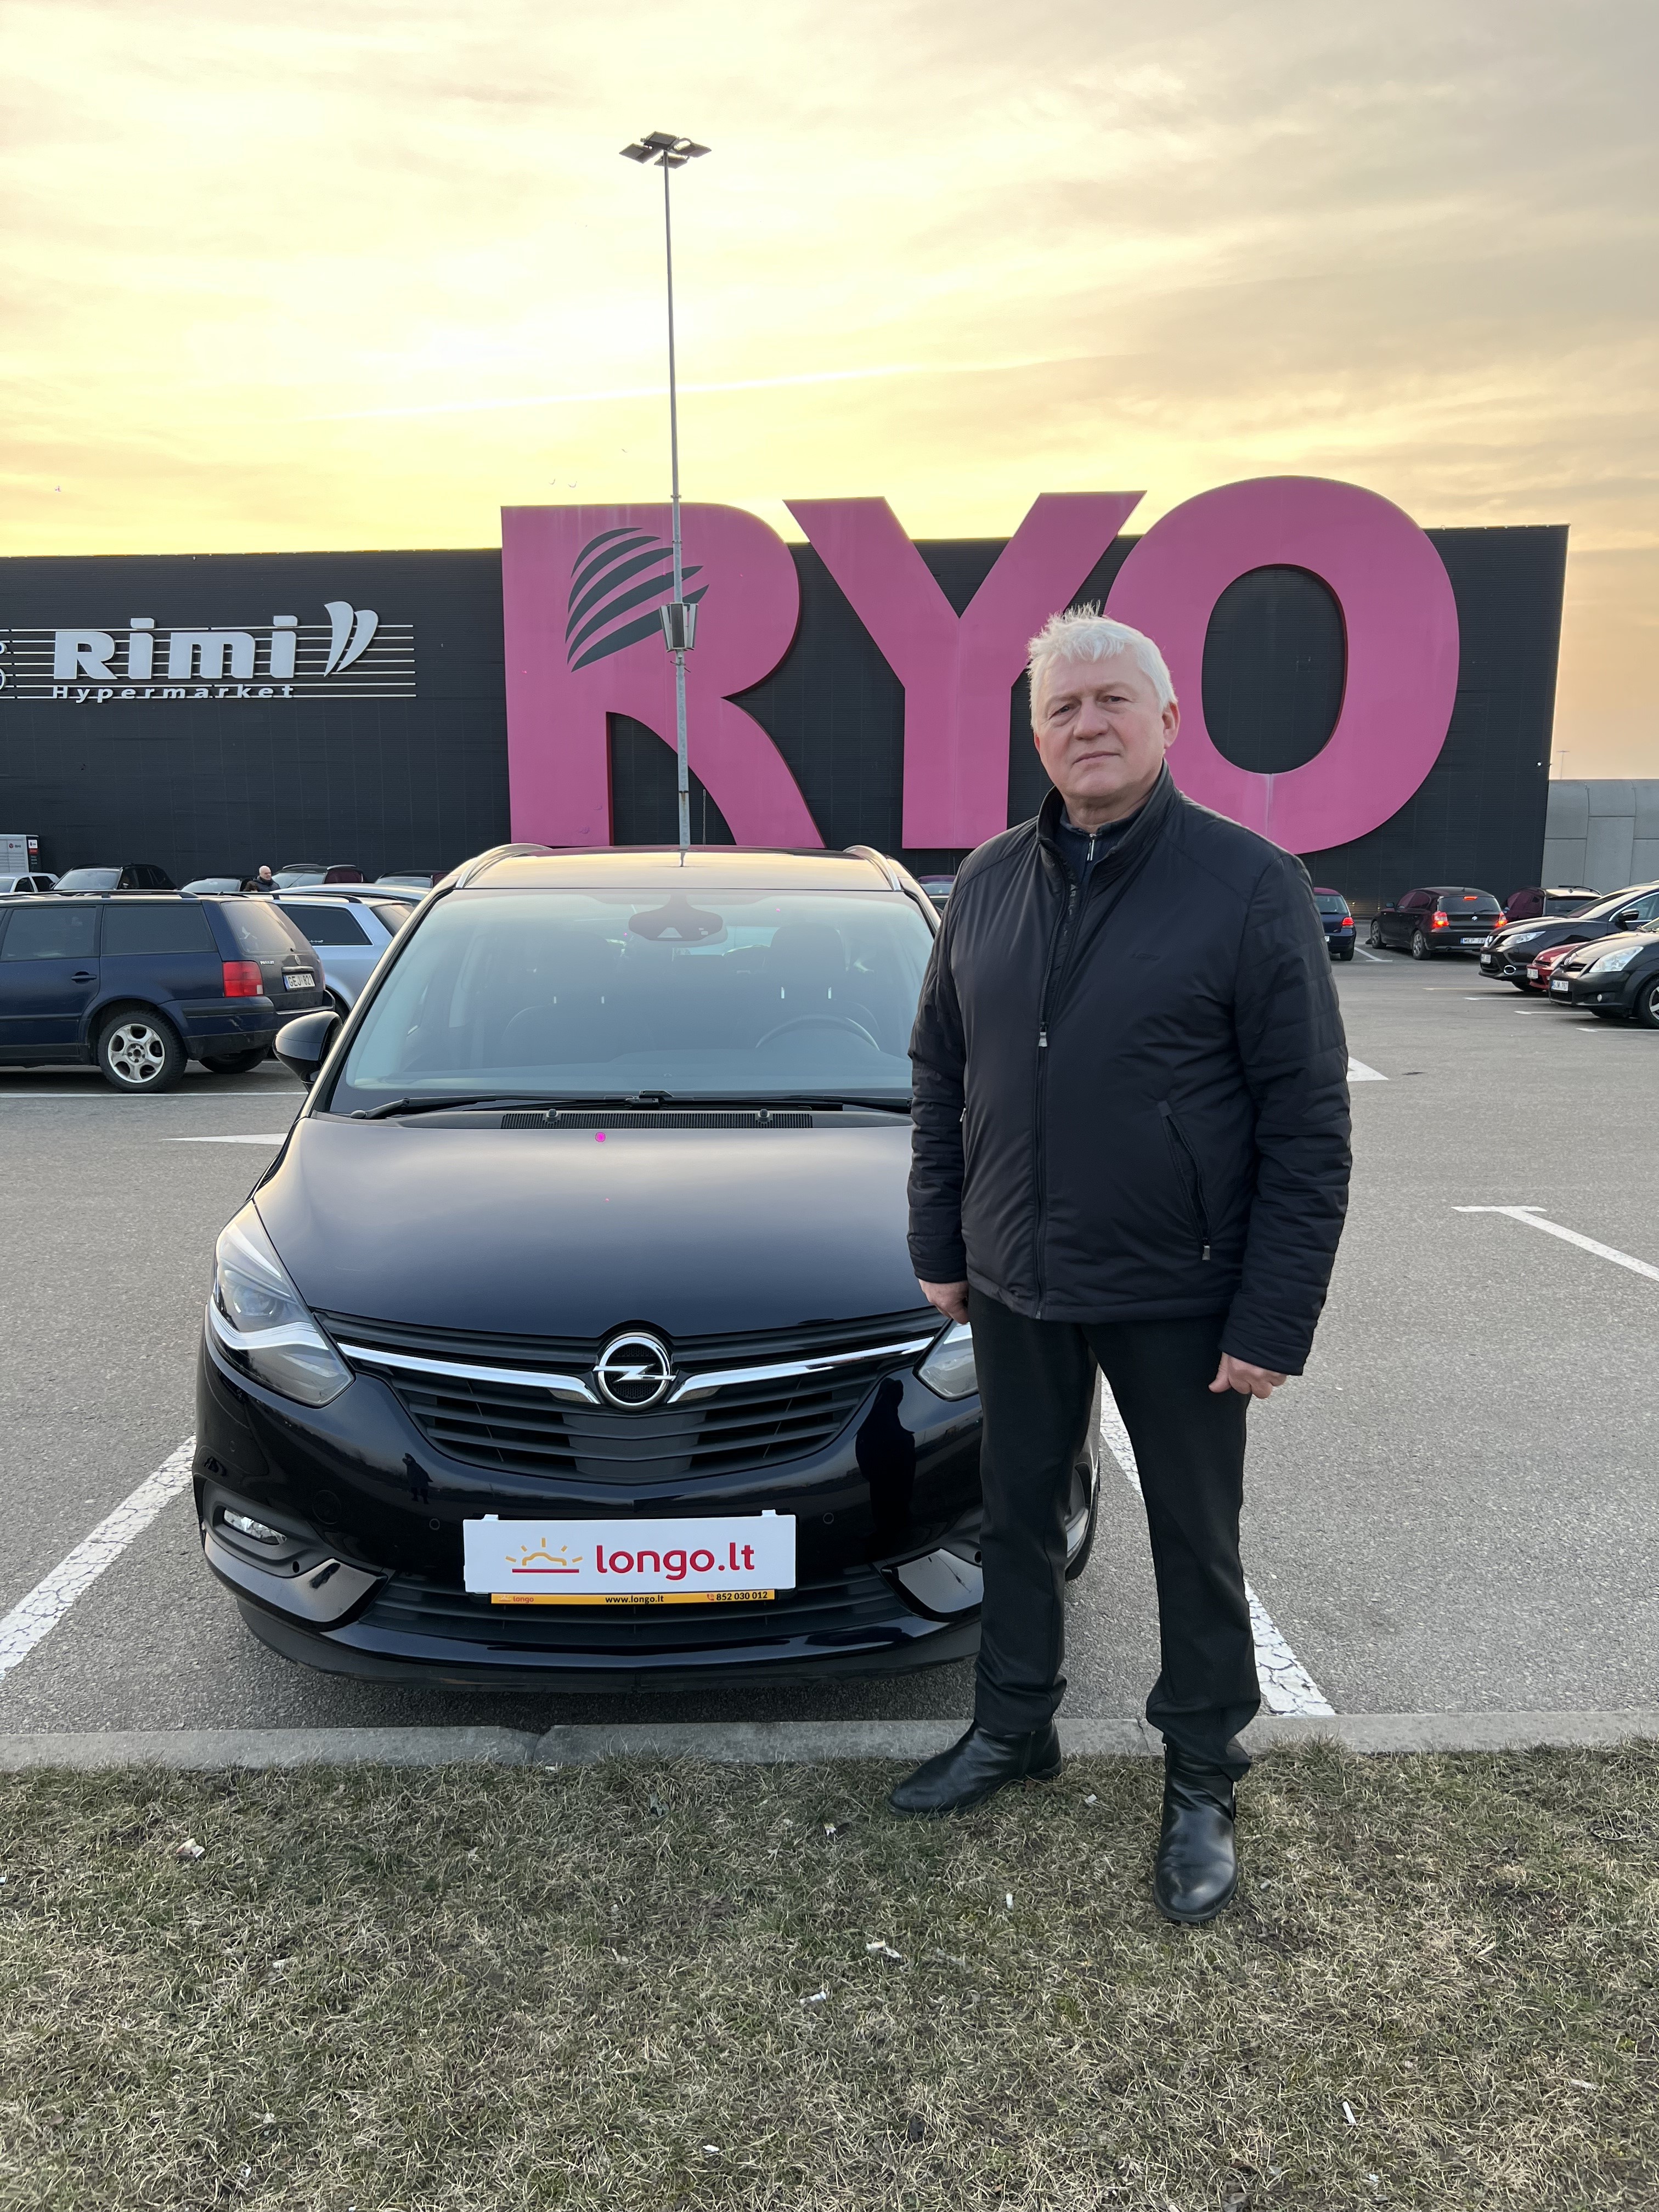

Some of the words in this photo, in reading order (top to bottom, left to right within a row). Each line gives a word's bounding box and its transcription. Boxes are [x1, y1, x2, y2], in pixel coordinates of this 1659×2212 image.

[53, 615, 298, 680] Rimi
[501, 475, 1460, 854] RYO
[53, 684, 294, 703] Hypermarket
[288, 976, 301, 986] GEJ
[303, 975, 314, 985] 821
[596, 1542, 755, 1581] longo.lt
[513, 1595, 534, 1604] longo
[605, 1594, 664, 1605] www.longo.lt
[716, 1593, 732, 1601] 852
[734, 1592, 751, 1600] 030
[752, 1591, 768, 1599] 012
